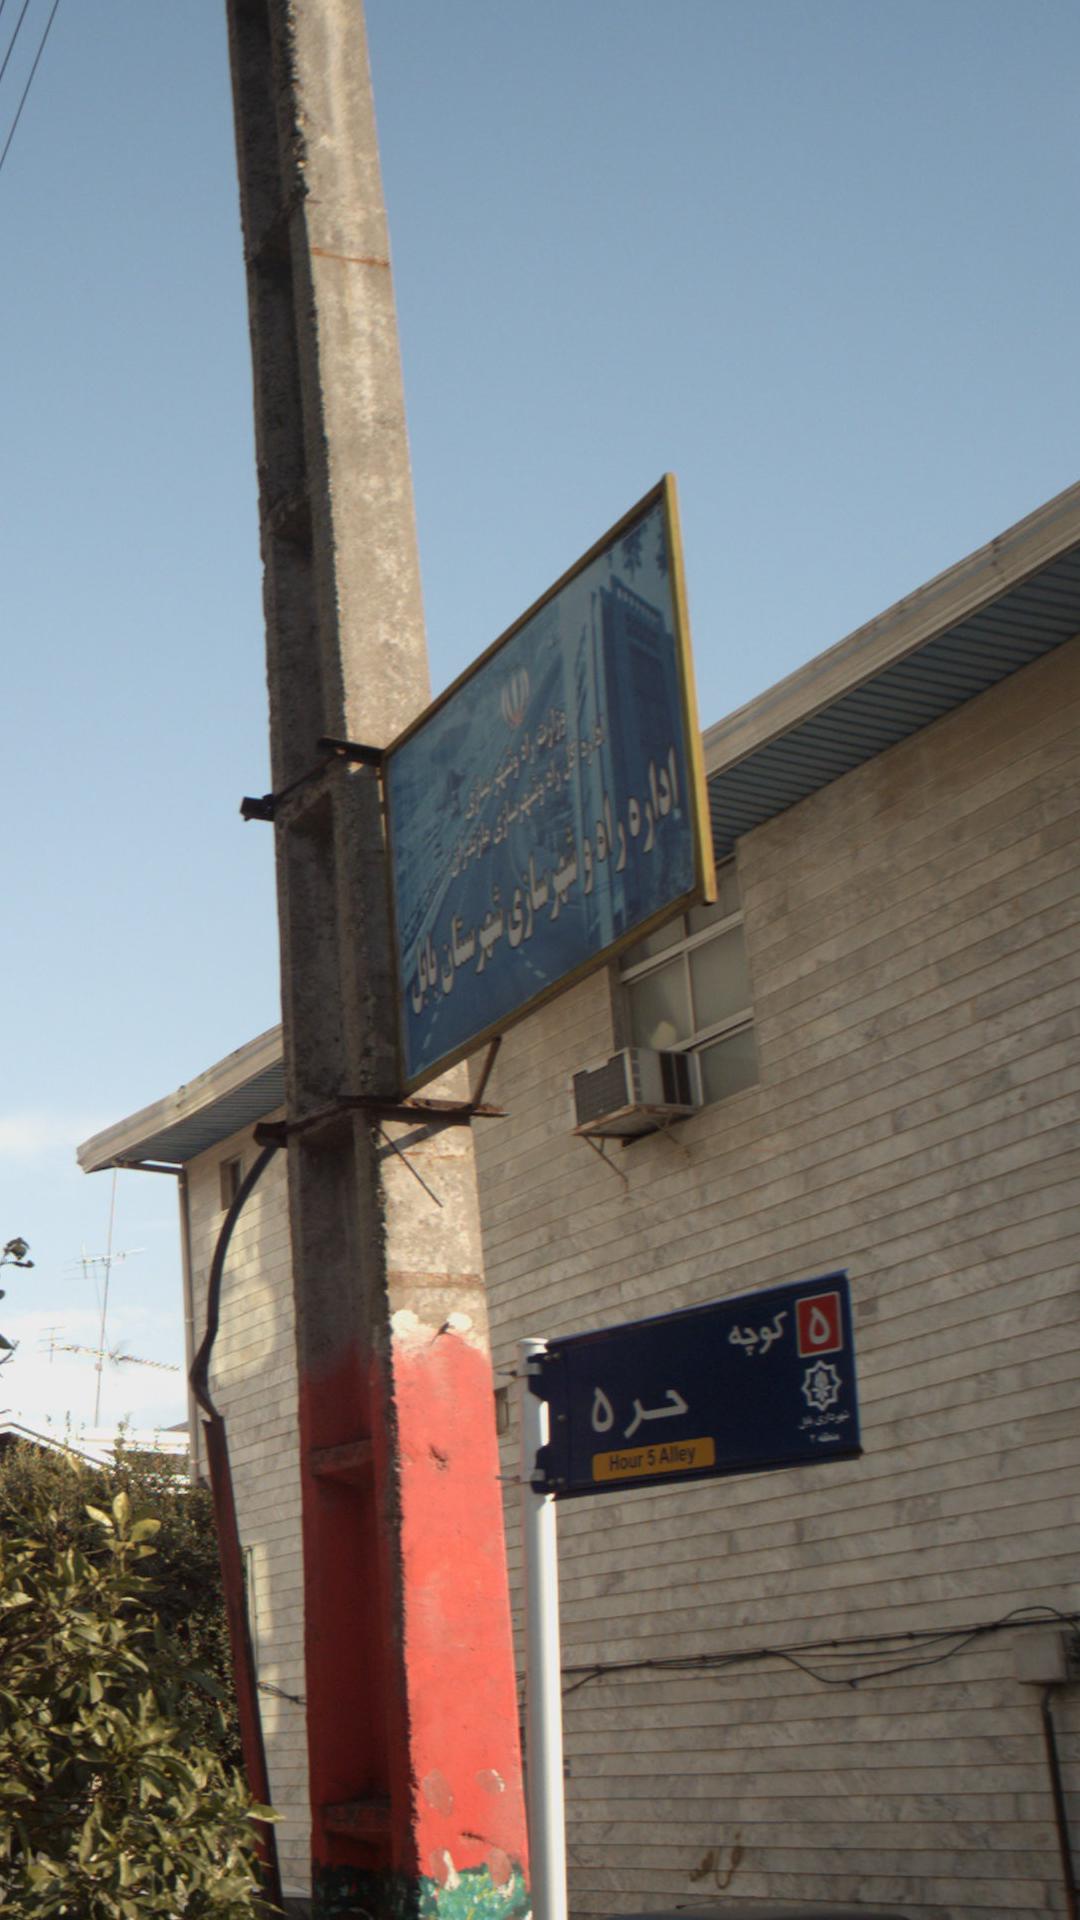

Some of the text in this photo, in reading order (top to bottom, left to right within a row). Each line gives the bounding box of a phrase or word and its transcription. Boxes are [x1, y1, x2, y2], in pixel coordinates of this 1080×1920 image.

[595, 791, 627, 873] راه
[627, 744, 680, 855] اداره
[411, 931, 438, 1015] بابل
[440, 882, 504, 995] شهرستان
[727, 1310, 789, 1356] کوچه
[609, 1445, 697, 1472] Hour 5 Alley
